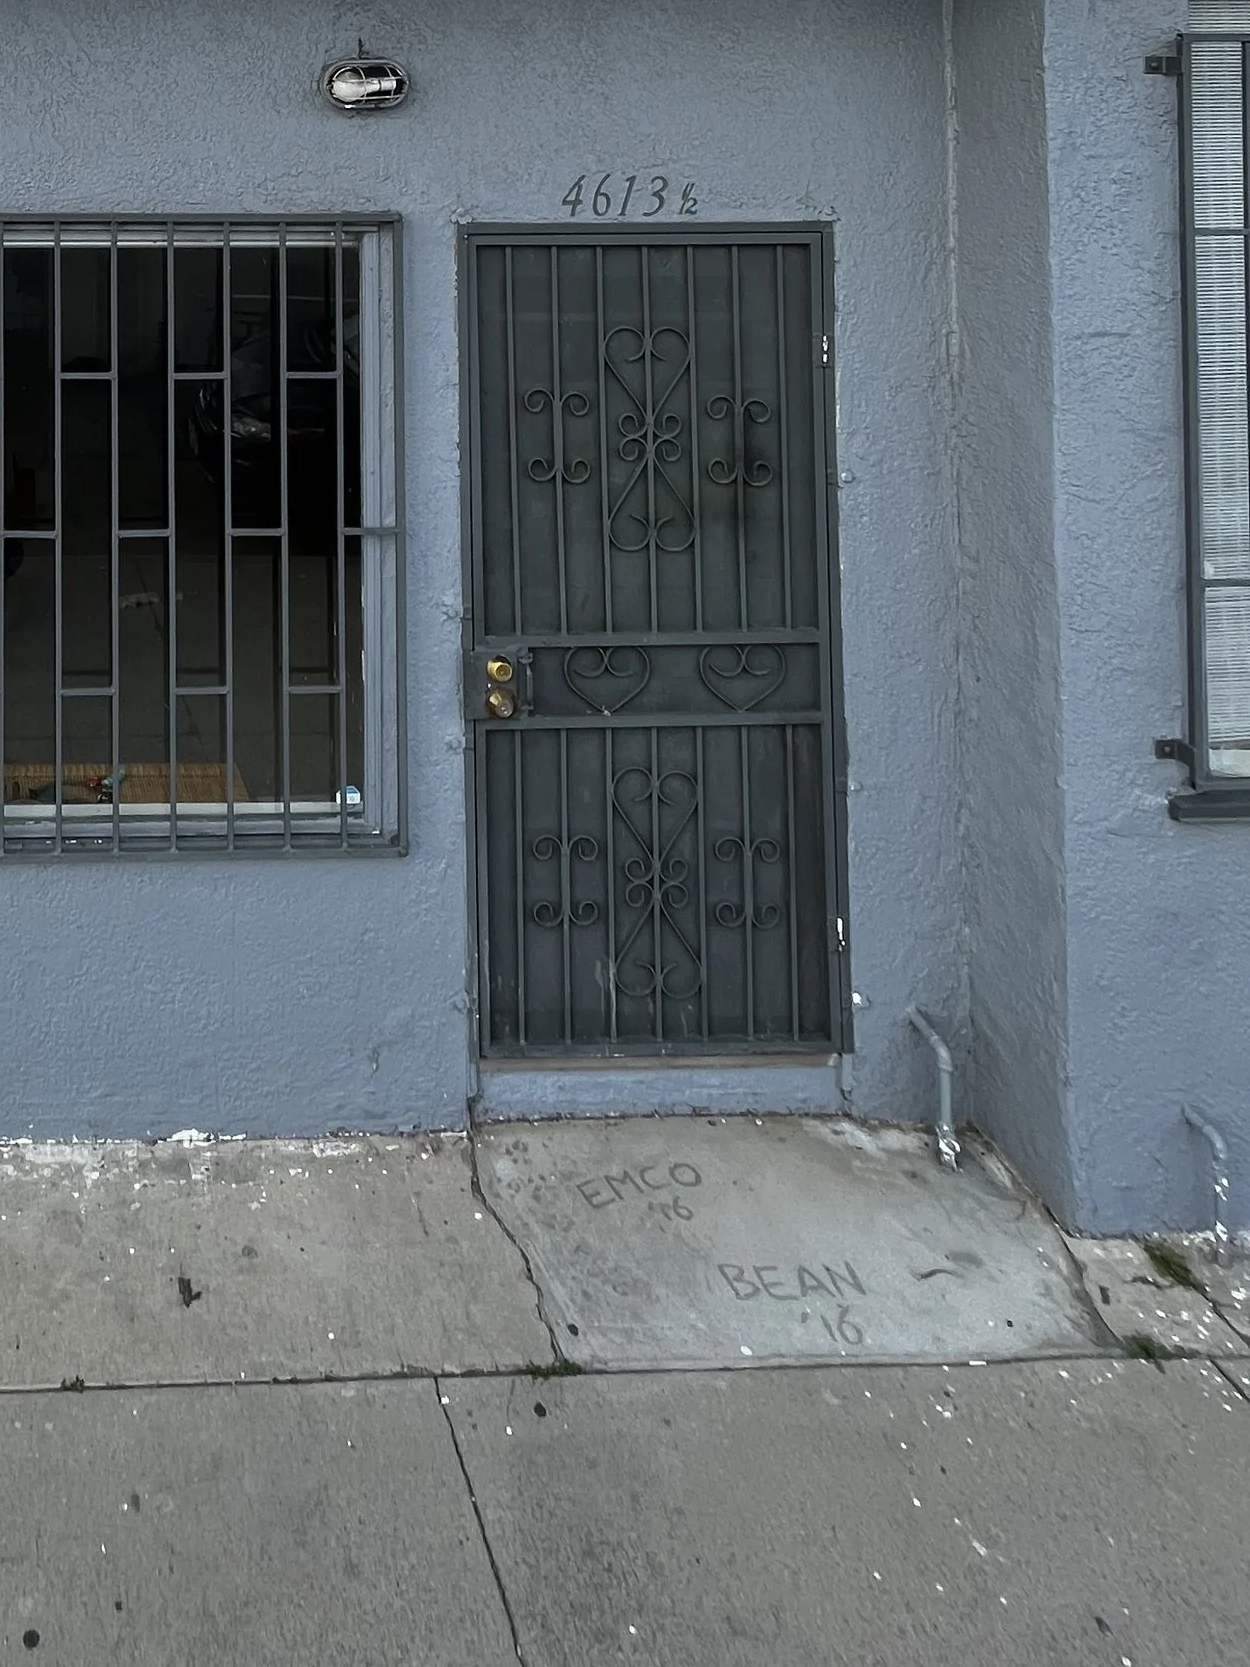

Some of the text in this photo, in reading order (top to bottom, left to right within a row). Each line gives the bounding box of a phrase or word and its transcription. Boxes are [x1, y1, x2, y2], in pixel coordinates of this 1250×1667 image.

[561, 173, 669, 217] 4613
[576, 1163, 702, 1209] EMCO
[716, 1260, 867, 1301] BEAN
